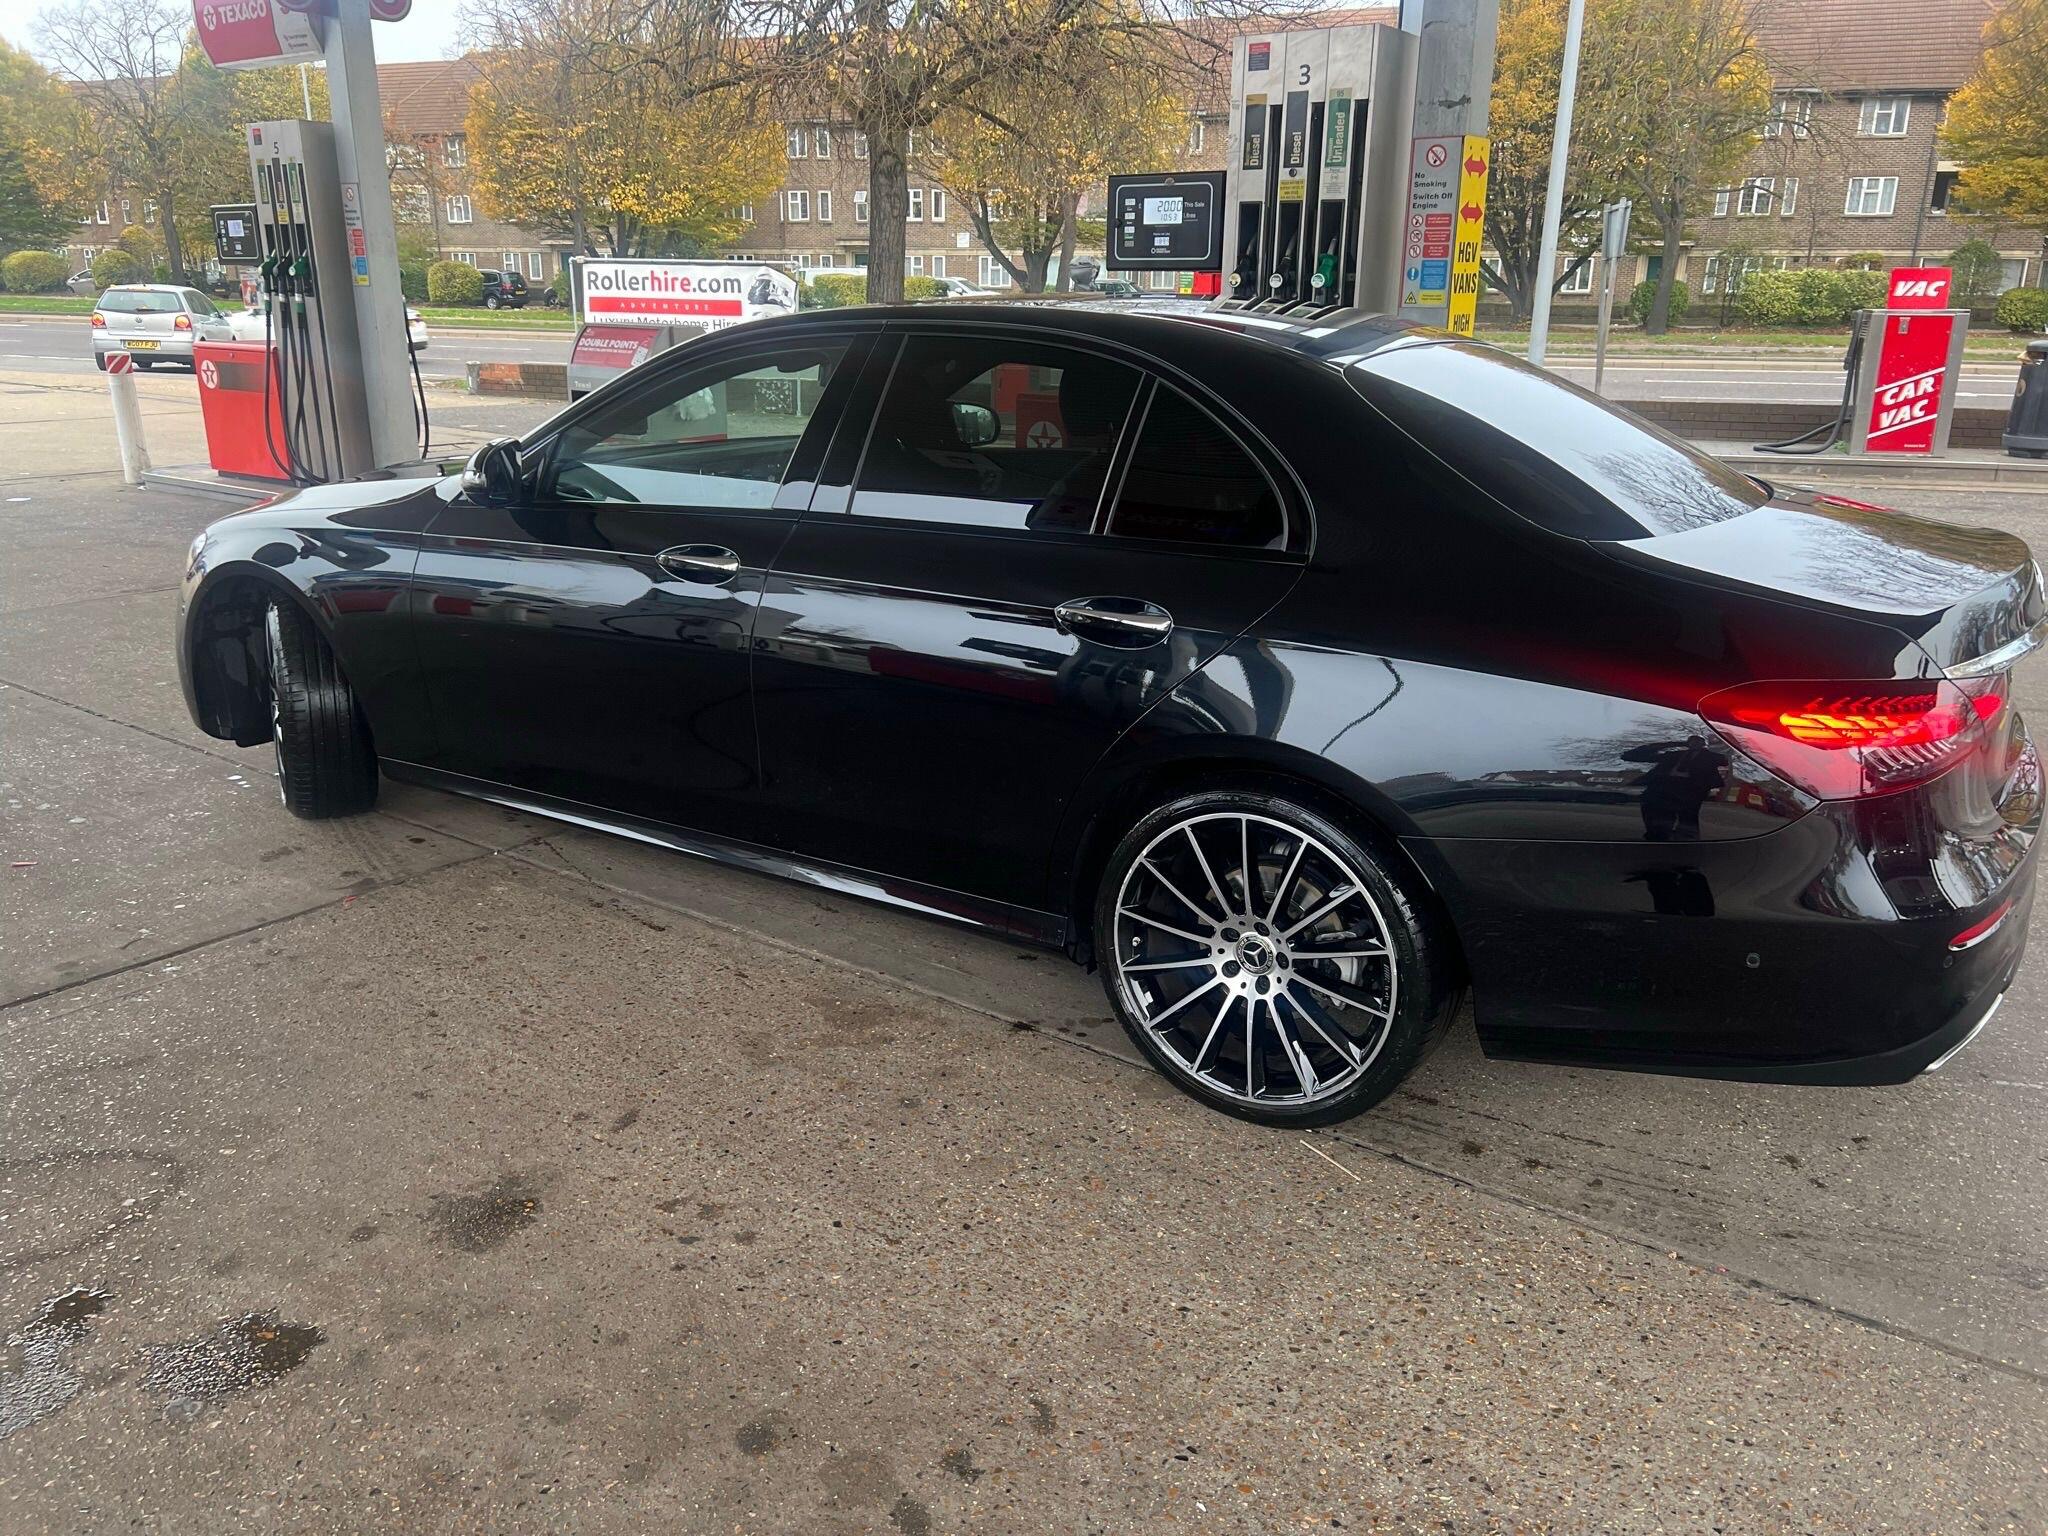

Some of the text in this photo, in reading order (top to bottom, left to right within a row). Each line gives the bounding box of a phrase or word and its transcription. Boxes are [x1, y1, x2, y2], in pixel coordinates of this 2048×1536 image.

[218, 1, 267, 24] TEXACO
[1299, 63, 1311, 85] 3
[273, 142, 280, 155] 5
[1290, 131, 1302, 164] Diesel
[1332, 112, 1346, 163] Unleaded
[1250, 134, 1261, 166] Diesel
[1458, 242, 1478, 262] HGV
[587, 269, 742, 293] Rollerhire.com
[1453, 273, 1477, 294] VANS
[1893, 280, 1946, 297] VAC
[620, 302, 710, 311] ADVENTURE
[1453, 314, 1471, 332] HIGH
[579, 338, 639, 349] DOUBLE POINTS
[1882, 376, 1935, 405] CAR
[1880, 399, 1929, 429] VAC
